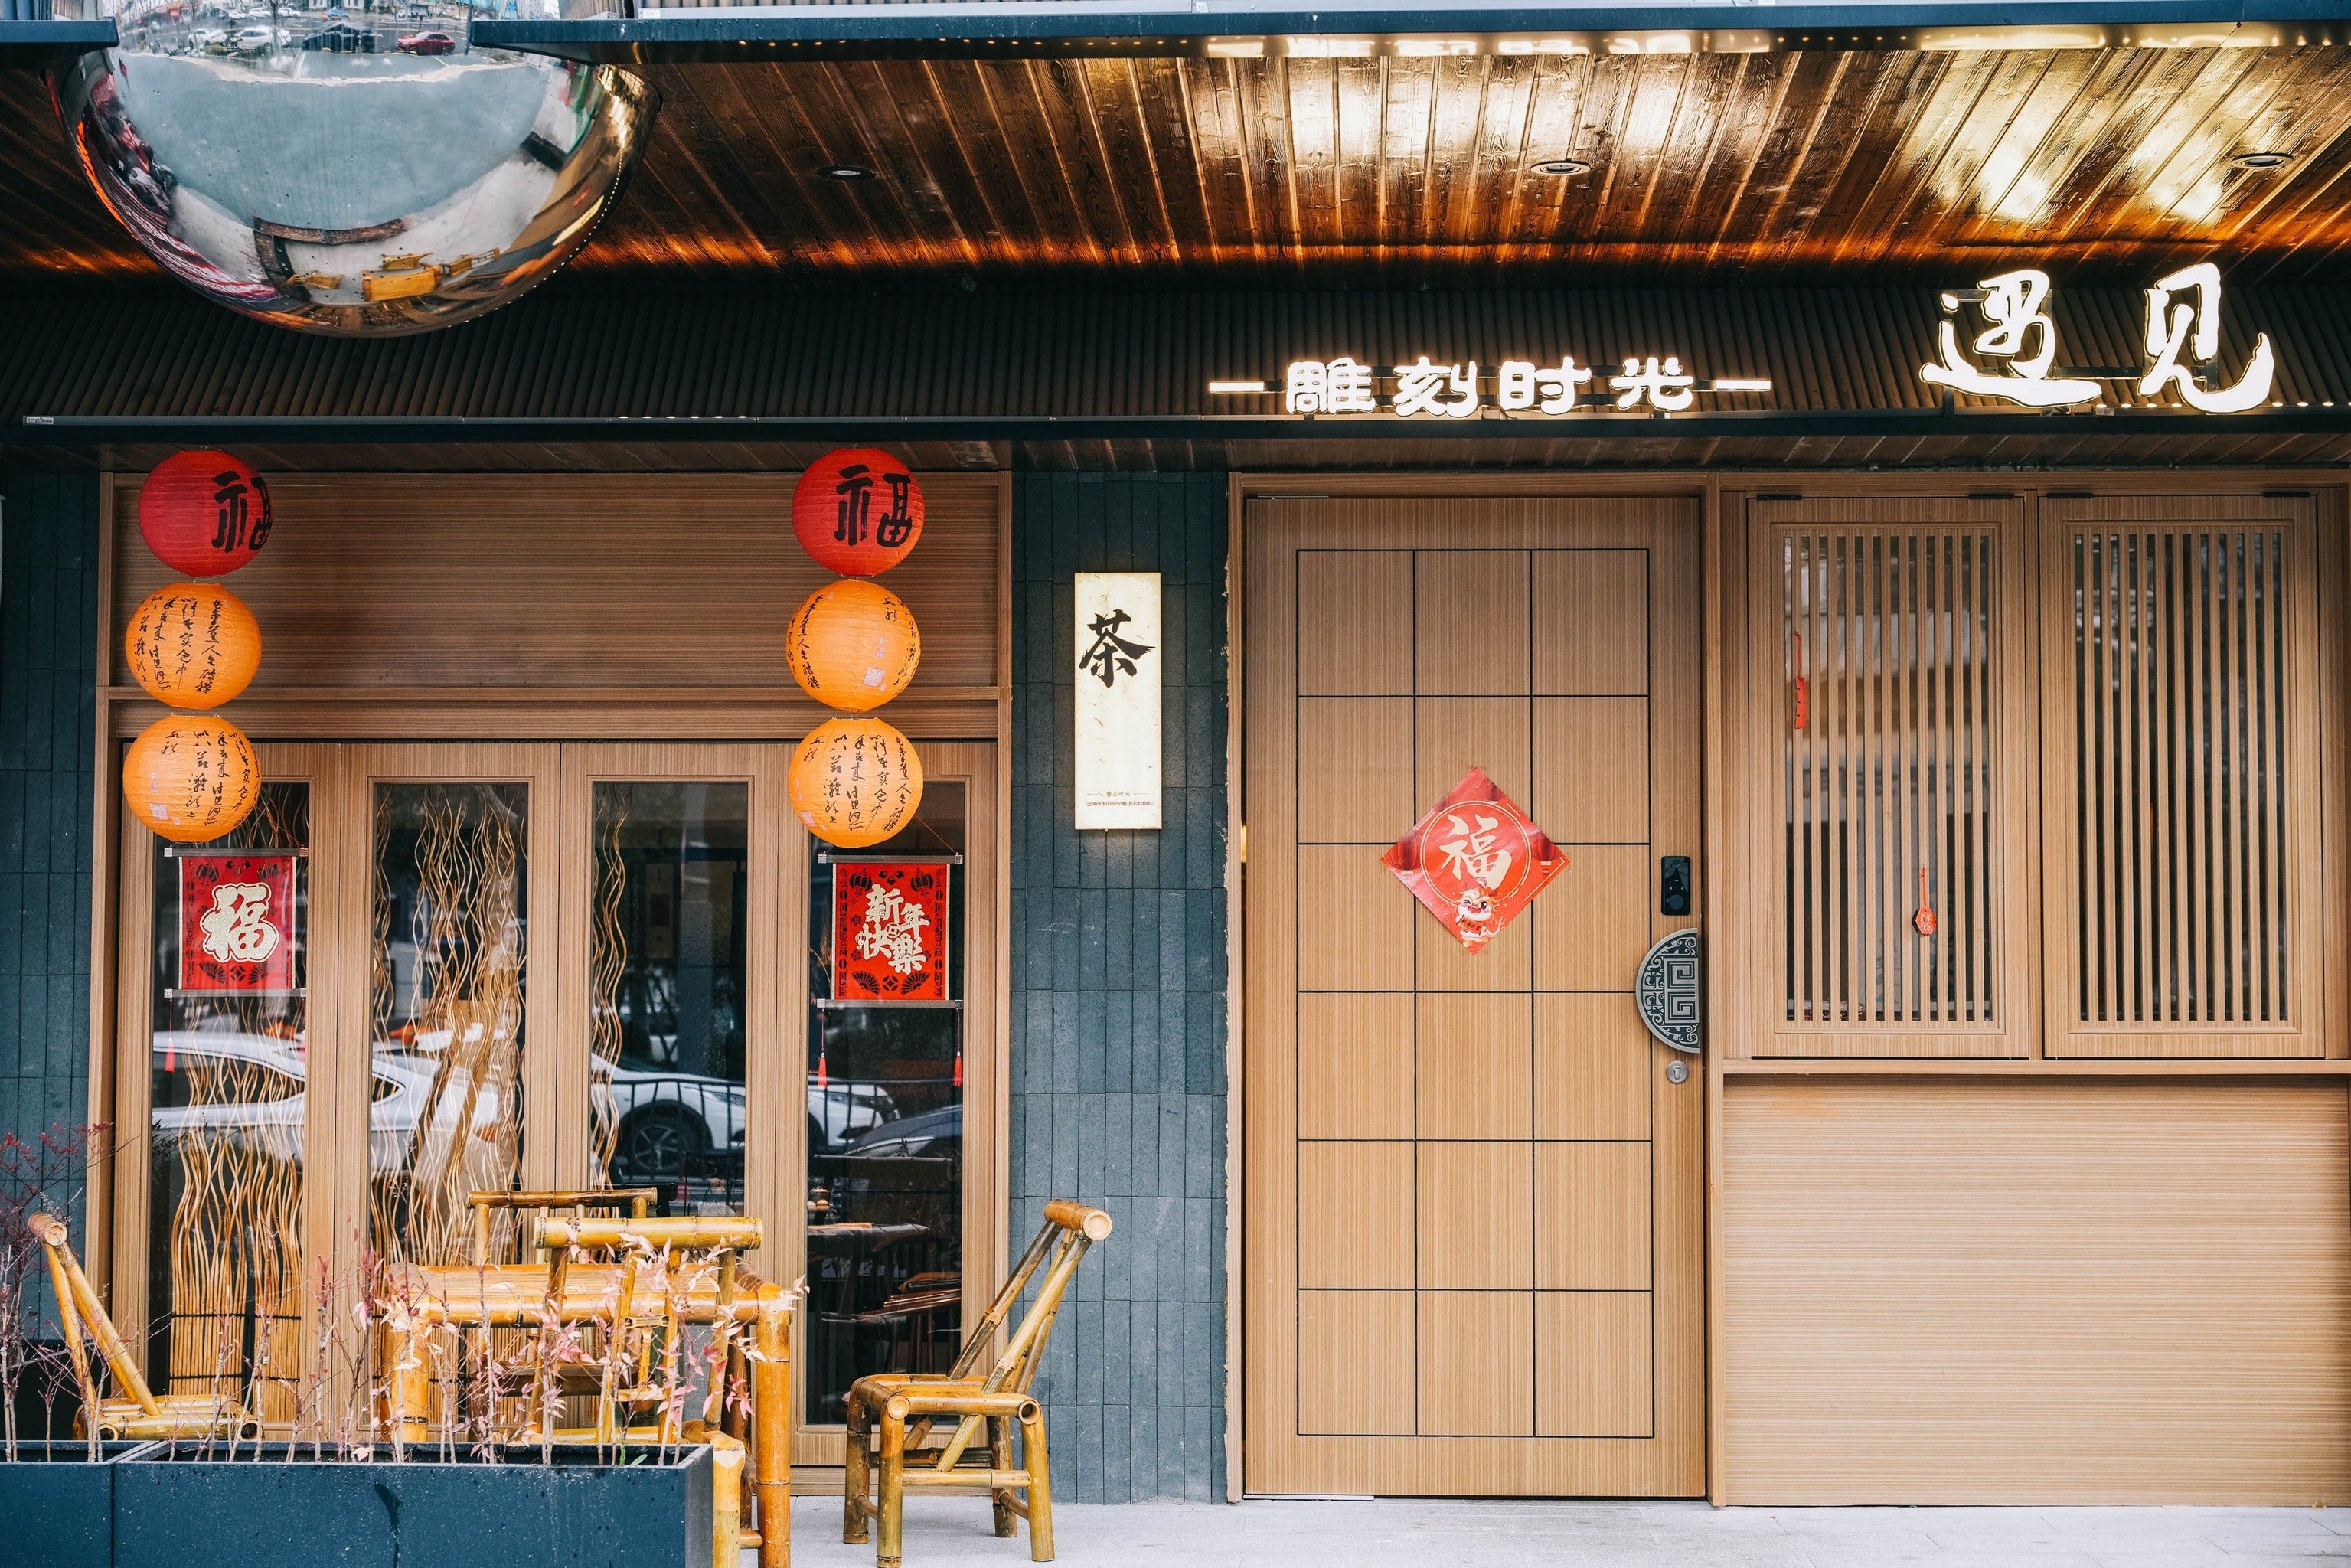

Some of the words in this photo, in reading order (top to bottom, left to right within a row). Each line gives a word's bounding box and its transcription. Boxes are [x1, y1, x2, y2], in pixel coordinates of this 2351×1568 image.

[1920, 262, 2275, 415] 遇见
[1285, 355, 1695, 418] 雕刻时光
[211, 470, 273, 553] 福
[833, 464, 913, 548] 福
[1079, 609, 1157, 689] 茶
[1439, 813, 1513, 890] 福
[200, 882, 279, 963] 福
